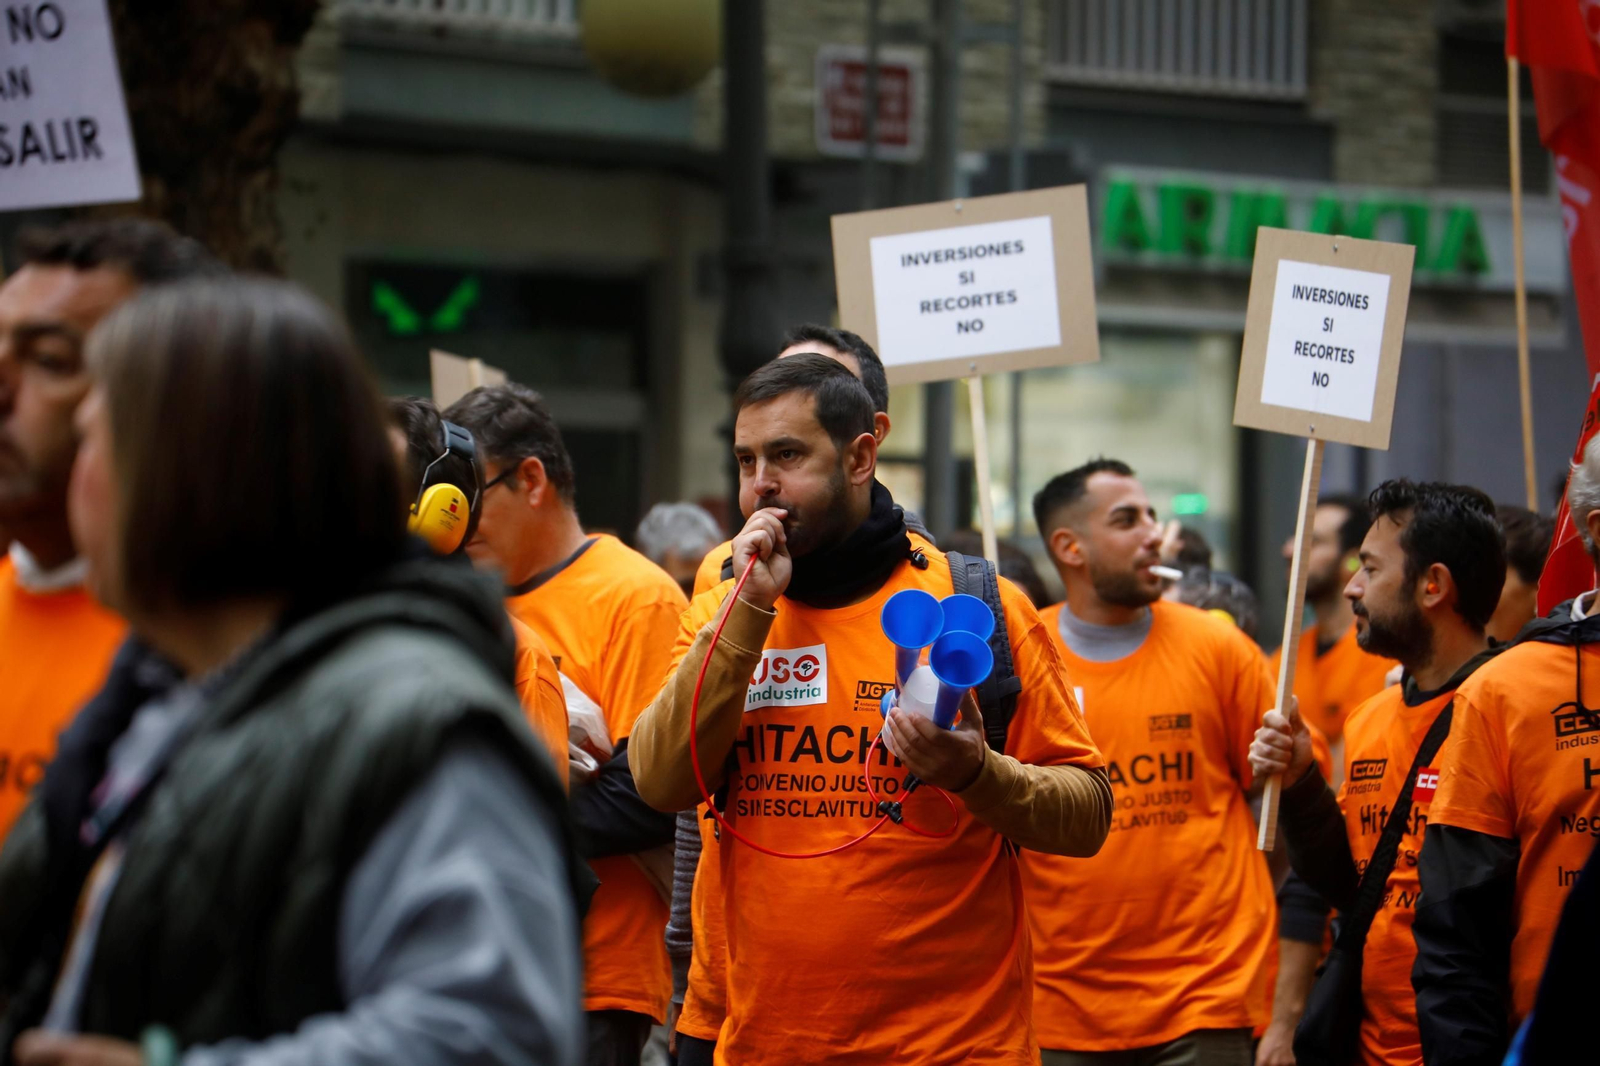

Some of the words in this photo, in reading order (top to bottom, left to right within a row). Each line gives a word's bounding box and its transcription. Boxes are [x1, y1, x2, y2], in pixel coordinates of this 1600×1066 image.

[6, 3, 65, 43] NO
[0, 117, 104, 168] SALIR
[900, 239, 1025, 268] INVERSIONES
[958, 270, 975, 286] SI
[919, 289, 1018, 314] RECORTES
[1292, 284, 1370, 310] INVERSIONES
[956, 318, 984, 335] NO
[1322, 317, 1334, 333] SI
[1294, 340, 1355, 364] RECORTES
[1311, 371, 1330, 388] NO
[748, 684, 821, 704] industria
[732, 723, 904, 767] HITACH
[829, 774, 899, 795] JUSTO
